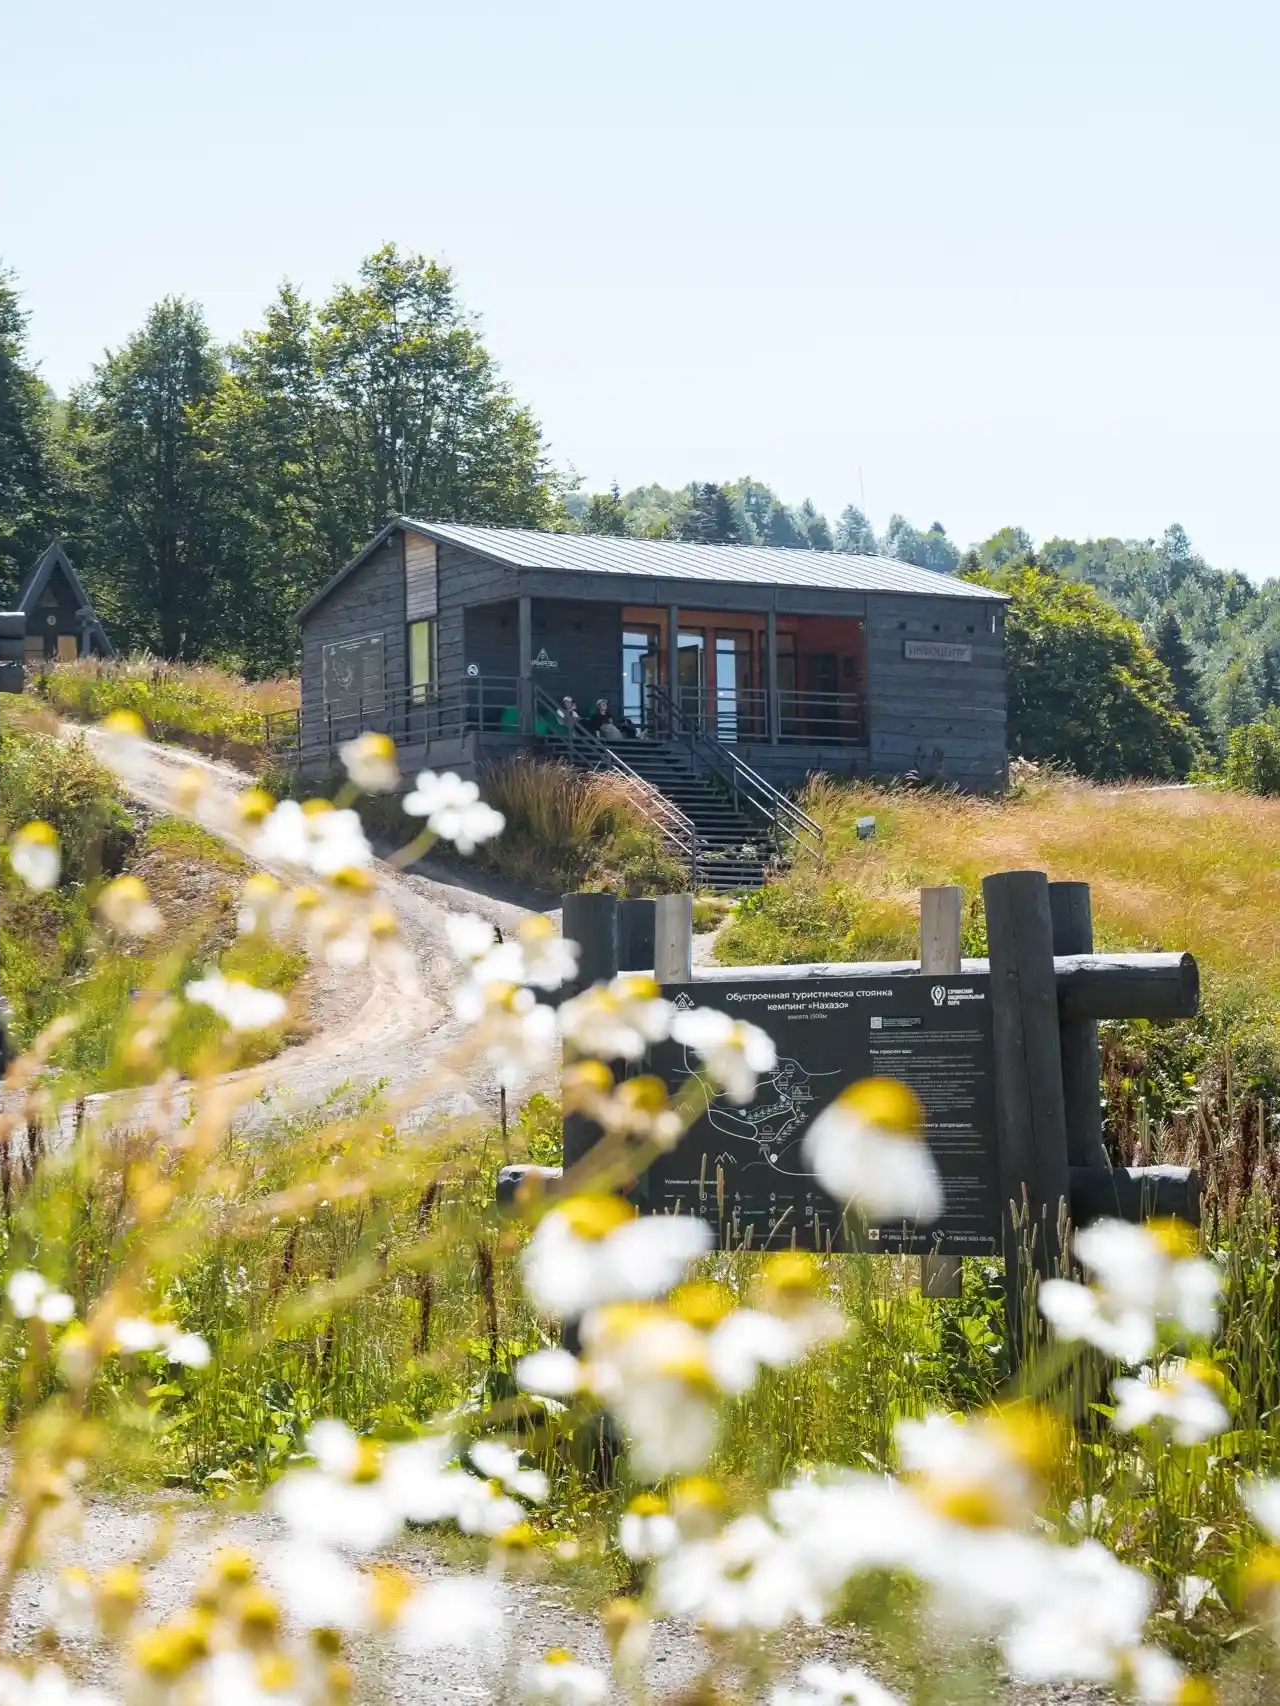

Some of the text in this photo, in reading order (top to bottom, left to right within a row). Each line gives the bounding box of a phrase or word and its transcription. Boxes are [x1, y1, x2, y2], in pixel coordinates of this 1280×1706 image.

[726, 988, 893, 1002] Обустроенная туристическа стоянка
[767, 1002, 849, 1011] кемпинг «Нахазо»
